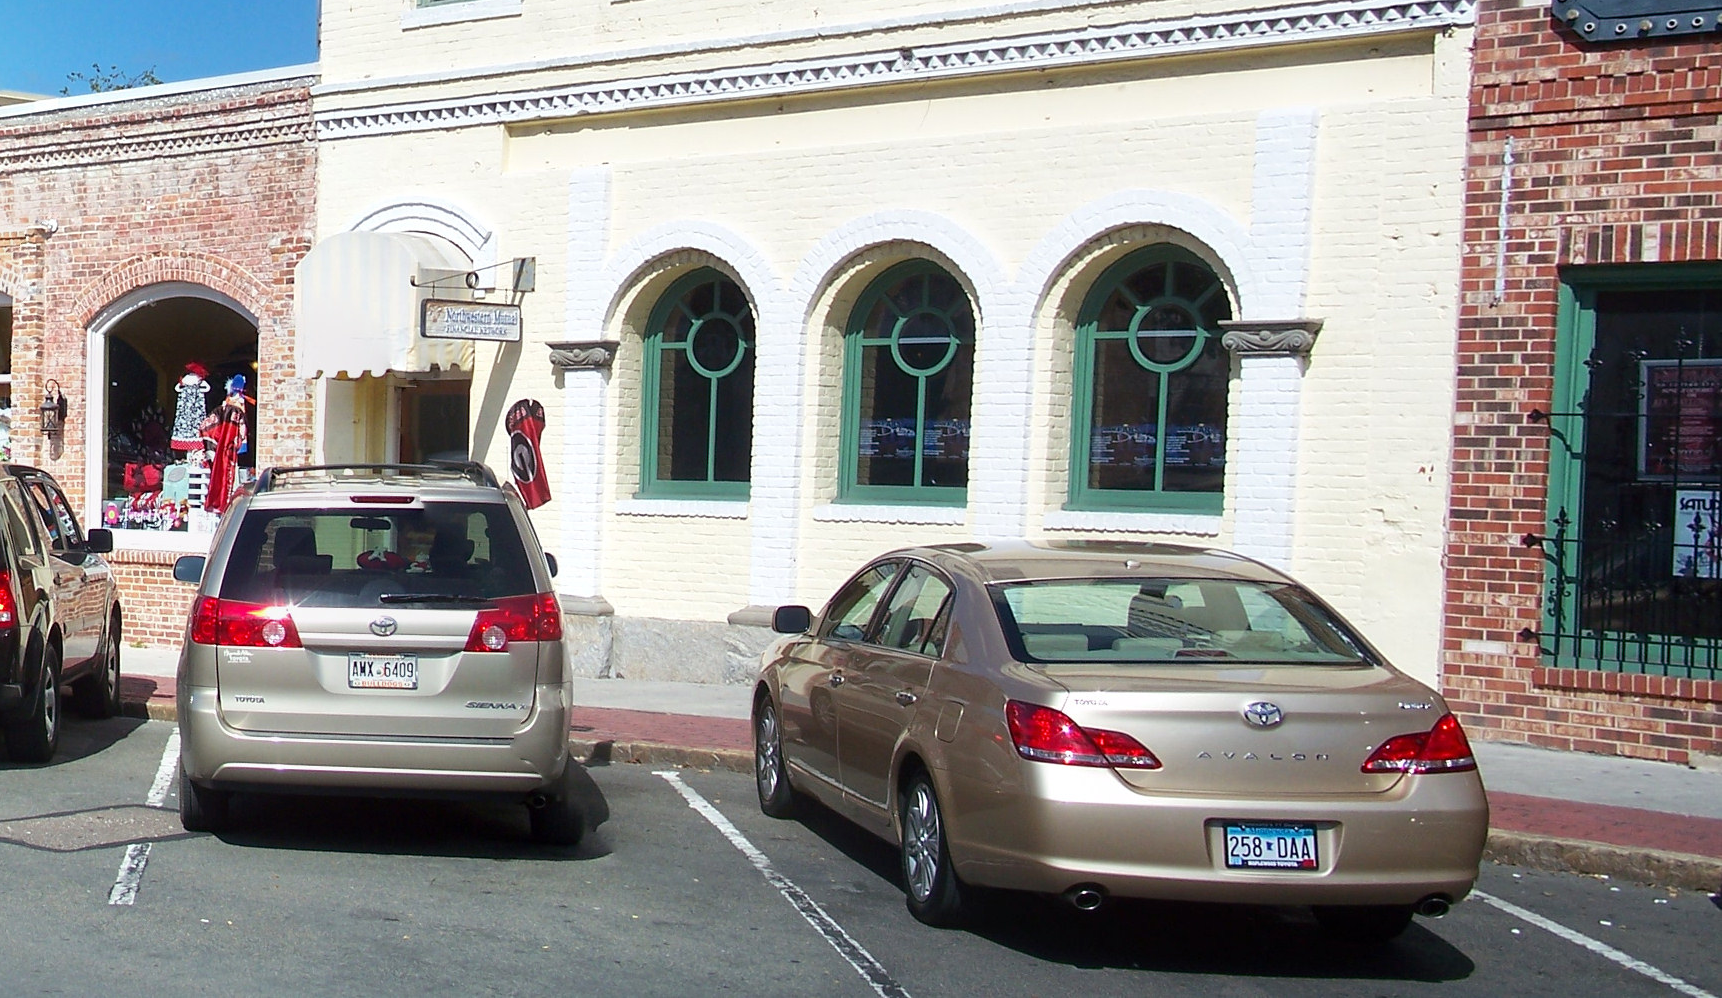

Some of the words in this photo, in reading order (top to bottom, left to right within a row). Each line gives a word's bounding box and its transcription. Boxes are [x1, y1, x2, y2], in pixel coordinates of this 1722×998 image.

[445, 307, 491, 325] Northwestern
[493, 310, 517, 326] Mutual
[352, 660, 374, 677] AMX
[384, 661, 414, 678] 6409
[234, 695, 266, 703] TOYOTA
[465, 700, 517, 710] SIENNA
[1196, 751, 1329, 762] AVALON
[1229, 835, 1263, 858] 258
[1276, 836, 1311, 859] DAA
